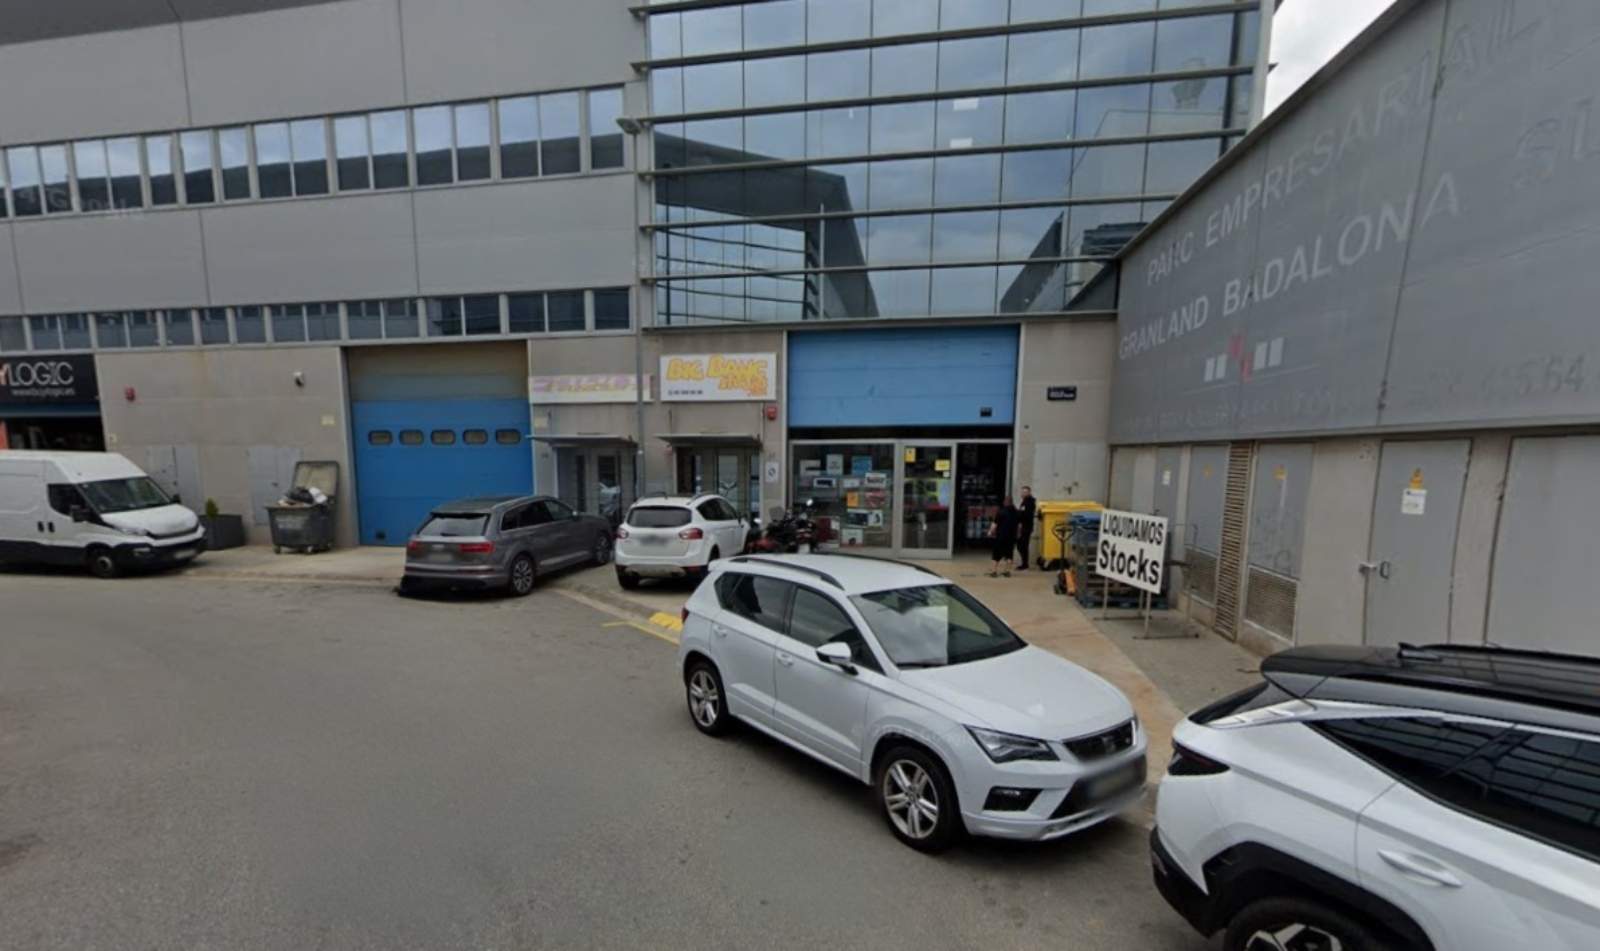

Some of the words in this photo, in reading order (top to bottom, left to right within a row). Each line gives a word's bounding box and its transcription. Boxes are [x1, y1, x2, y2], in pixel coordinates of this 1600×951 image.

[1119, 295, 1209, 360] GRANLAND
[1223, 172, 1459, 317] BADALONA
[667, 358, 704, 381] BIG
[1102, 512, 1164, 546] LIQUIDAMOS
[1099, 539, 1160, 585] Stocks
